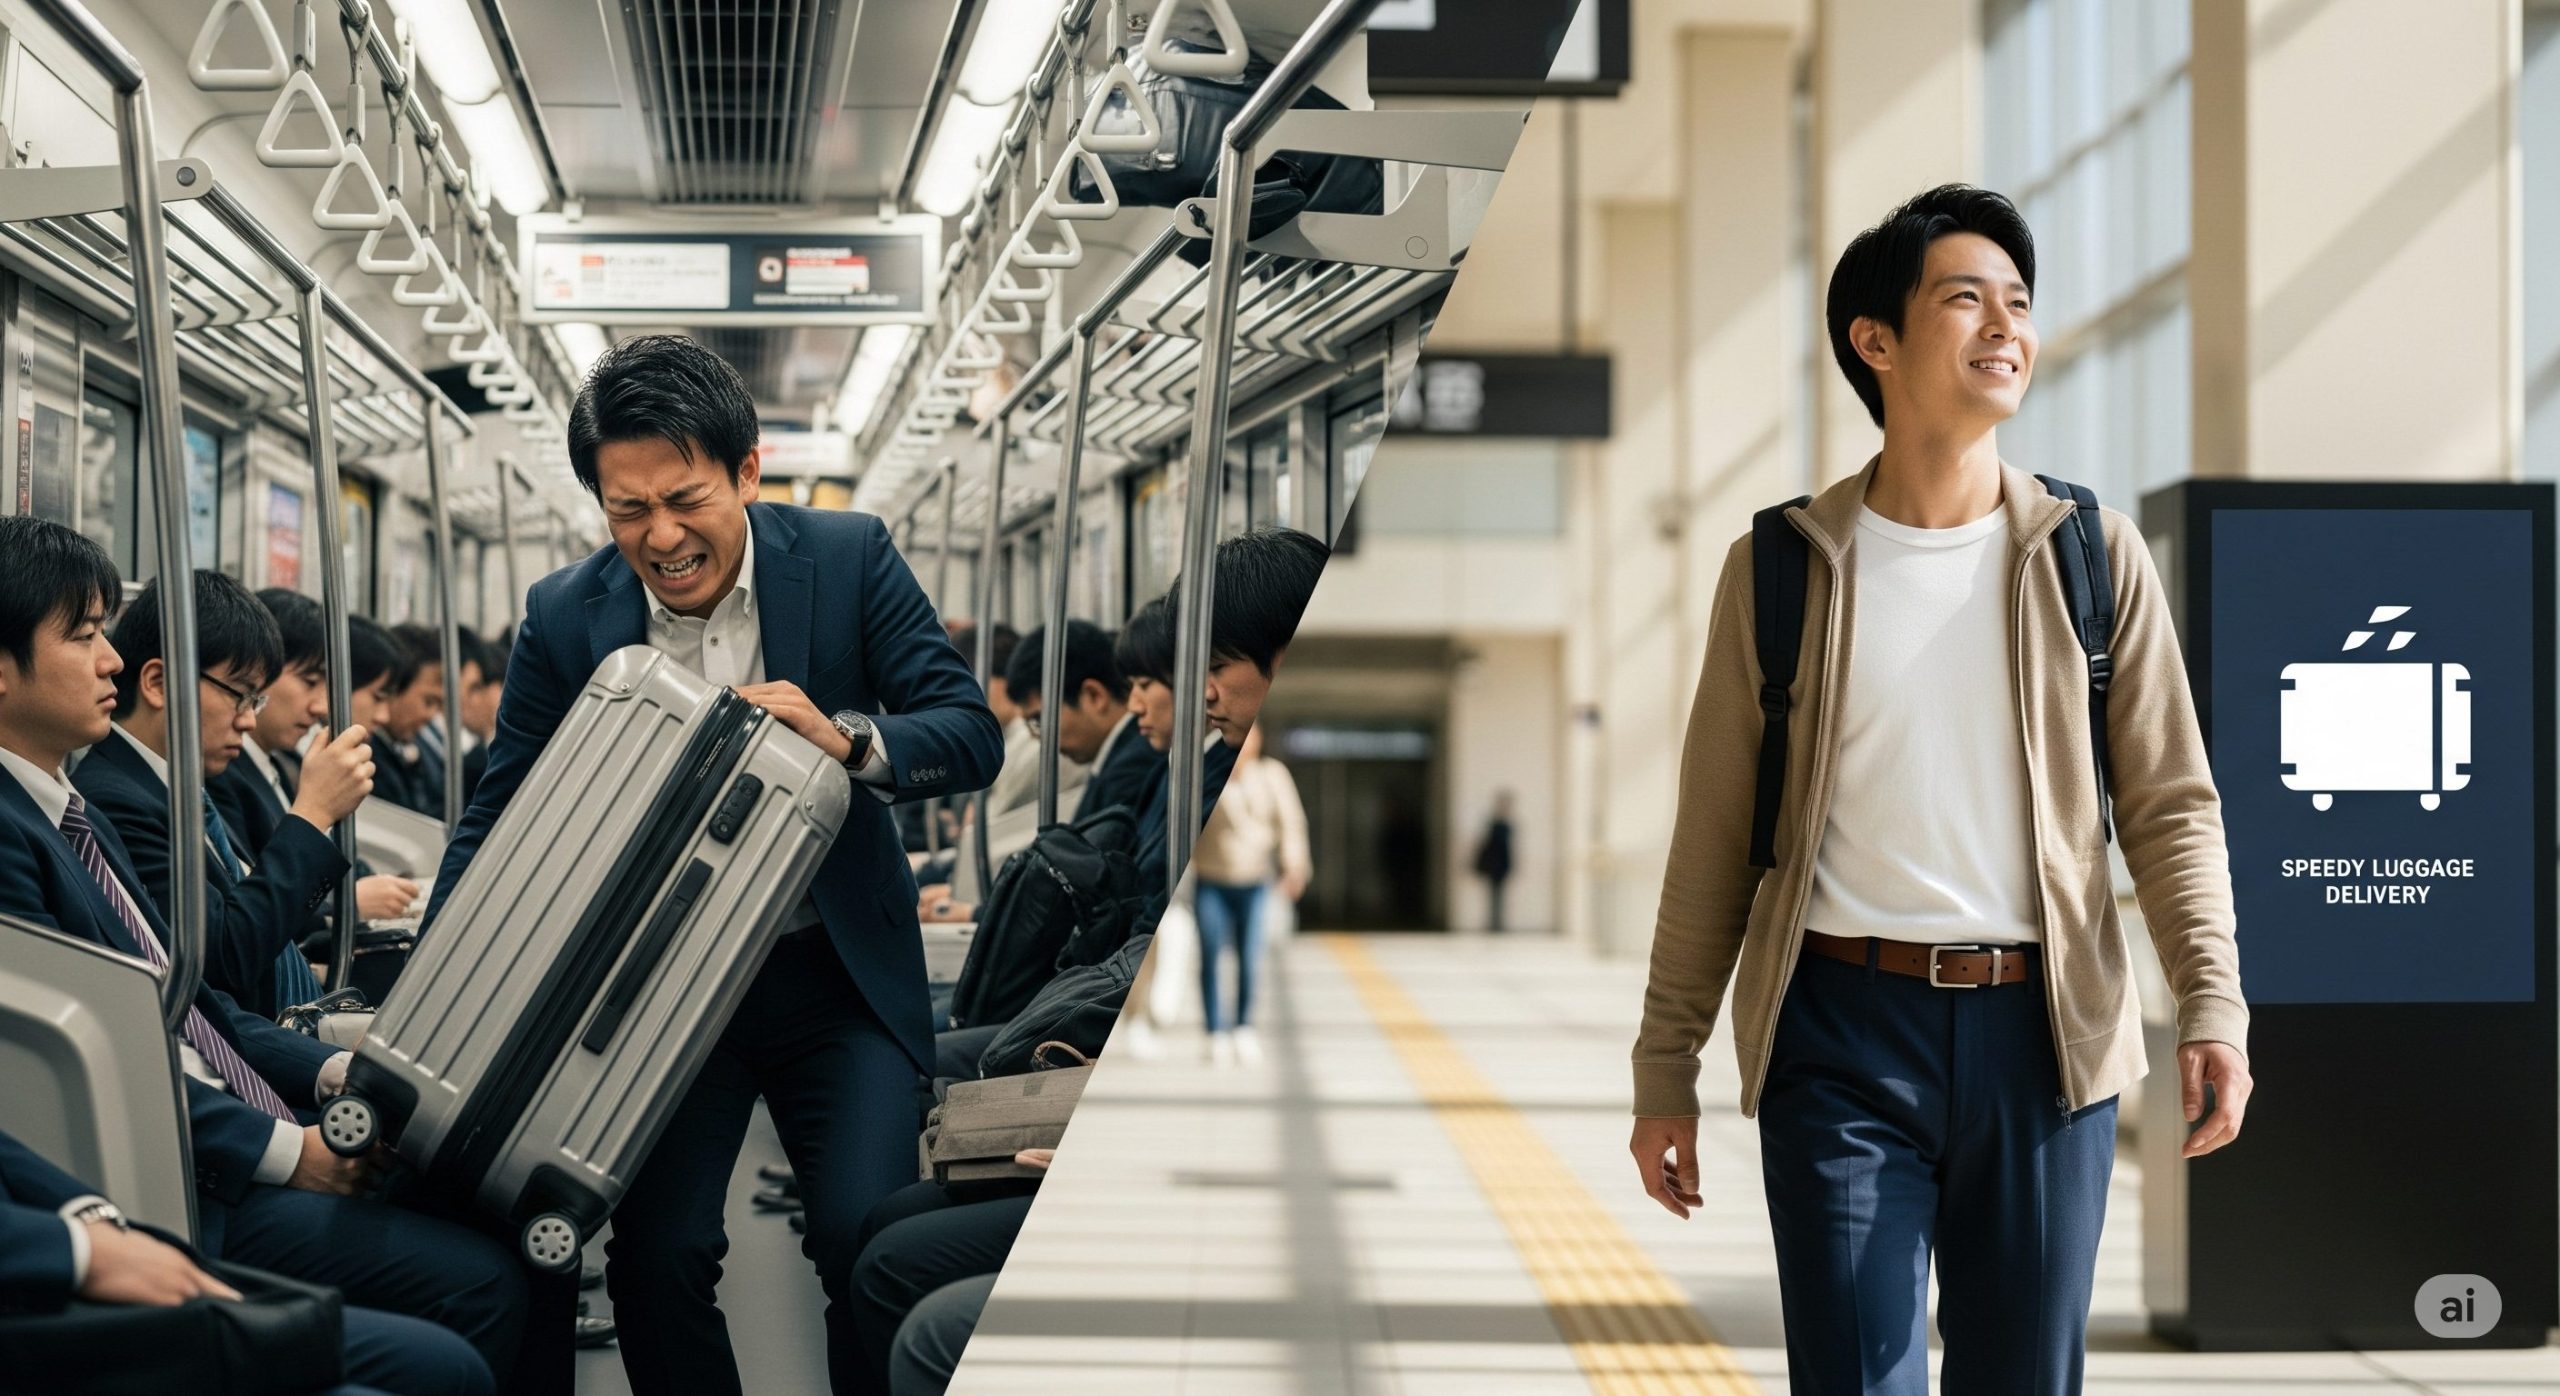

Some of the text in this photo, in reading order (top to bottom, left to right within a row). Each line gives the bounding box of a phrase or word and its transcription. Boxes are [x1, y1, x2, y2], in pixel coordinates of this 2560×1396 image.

[2281, 858, 2475, 878] SPEEDY LUGGAGE
[2325, 885, 2431, 905] DELIVERY
